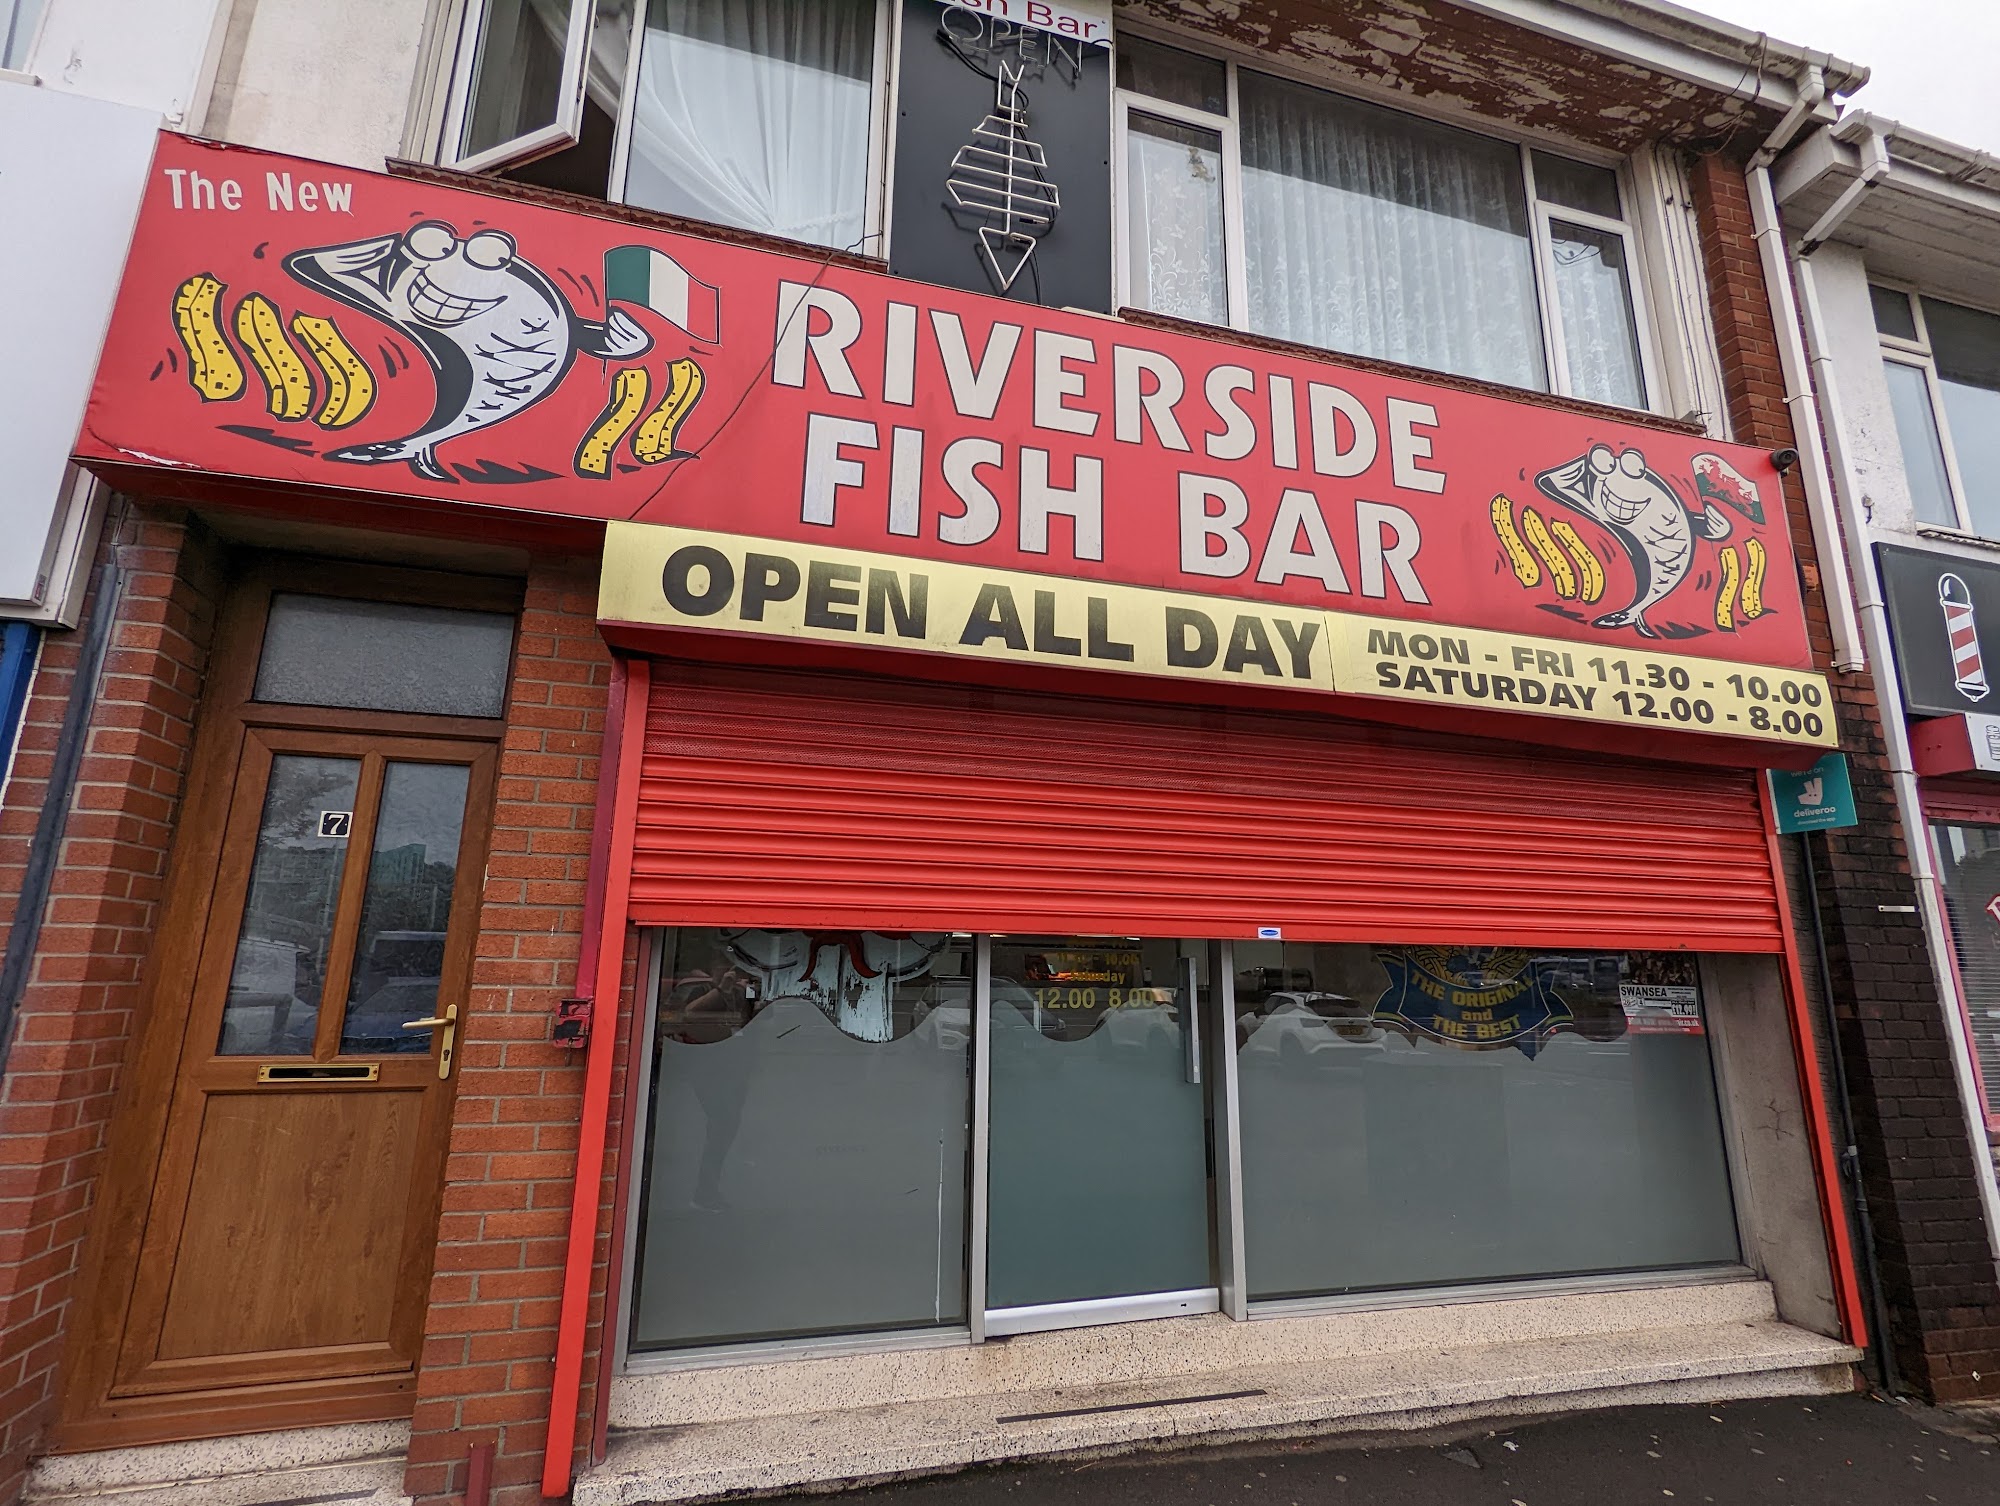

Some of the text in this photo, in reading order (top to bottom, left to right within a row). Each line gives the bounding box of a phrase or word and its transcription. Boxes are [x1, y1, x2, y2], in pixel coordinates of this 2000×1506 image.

[1027, 1, 1098, 38] Bar
[942, 6, 1083, 73] OPEN
[164, 169, 352, 212] The New
[771, 279, 1447, 495] RIVERSIDE
[800, 411, 1433, 606] FISH BAR
[662, 545, 1321, 680] OPEN ALL DAY
[1367, 628, 1471, 665] MON
[1511, 645, 1575, 678] FRI
[1587, 656, 1690, 691] 11.30
[1726, 674, 1822, 708] 10.00
[1375, 661, 1597, 711] SATURDAY
[1612, 690, 1714, 724] 12.00
[1748, 705, 1823, 737] 8.00
[1791, 766, 1825, 778] were on
[328, 814, 345, 835] 7
[1794, 806, 1836, 818] deliveroo
[1035, 986, 1096, 1009] 12.00
[1411, 970, 1535, 1008] THE ORIGINAL
[1620, 986, 1668, 997] SWANSEA
[1431, 1013, 1521, 1040] THE BEST
[1461, 1008, 1493, 1021] and
